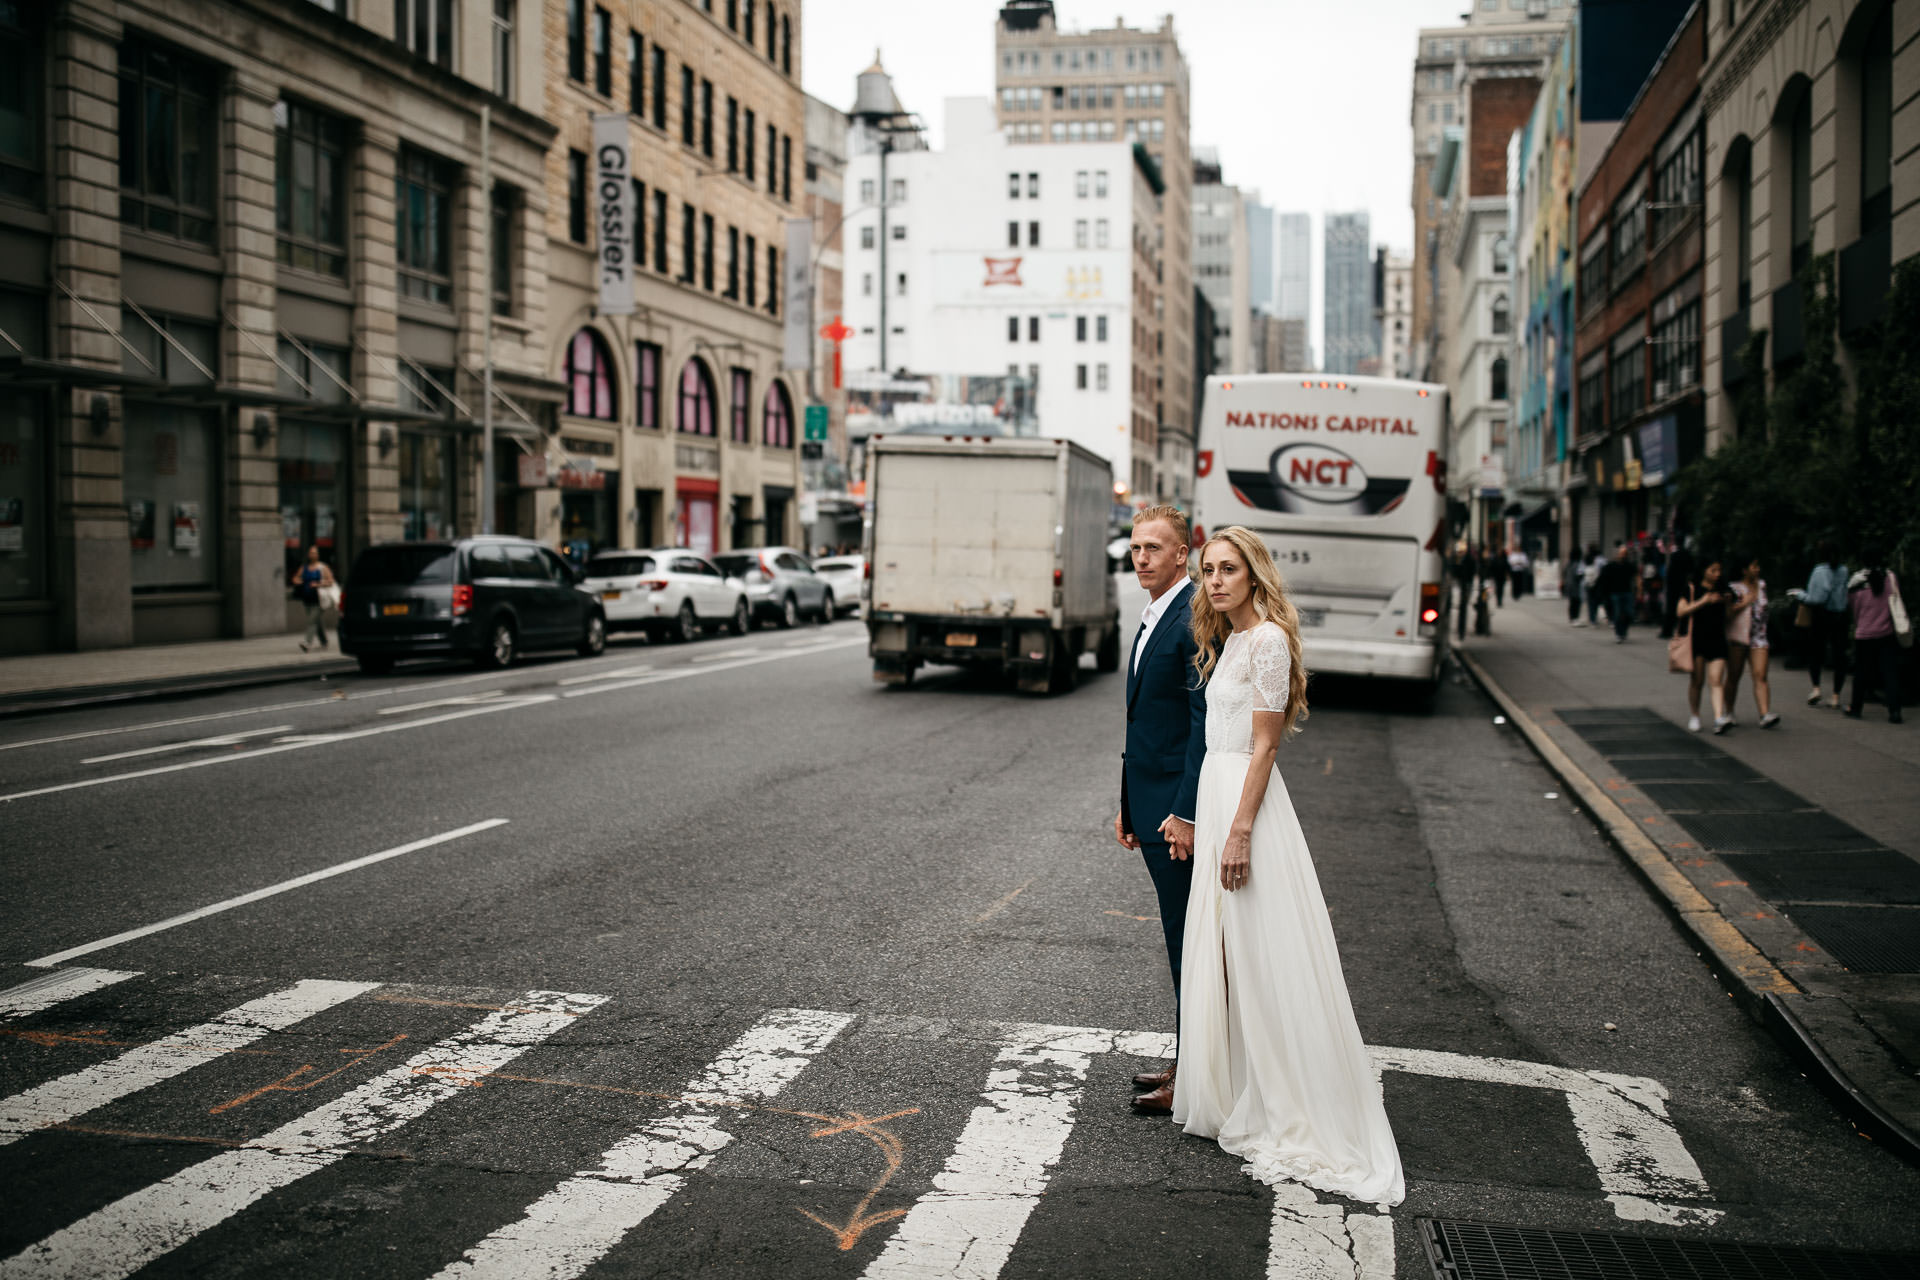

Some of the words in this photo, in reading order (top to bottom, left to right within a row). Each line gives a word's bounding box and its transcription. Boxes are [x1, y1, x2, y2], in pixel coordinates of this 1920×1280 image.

[598, 144, 631, 284] Glossier.
[1225, 411, 1319, 431] NATIONS
[1325, 415, 1419, 436] CAPITAL
[1289, 457, 1354, 486] NCT
